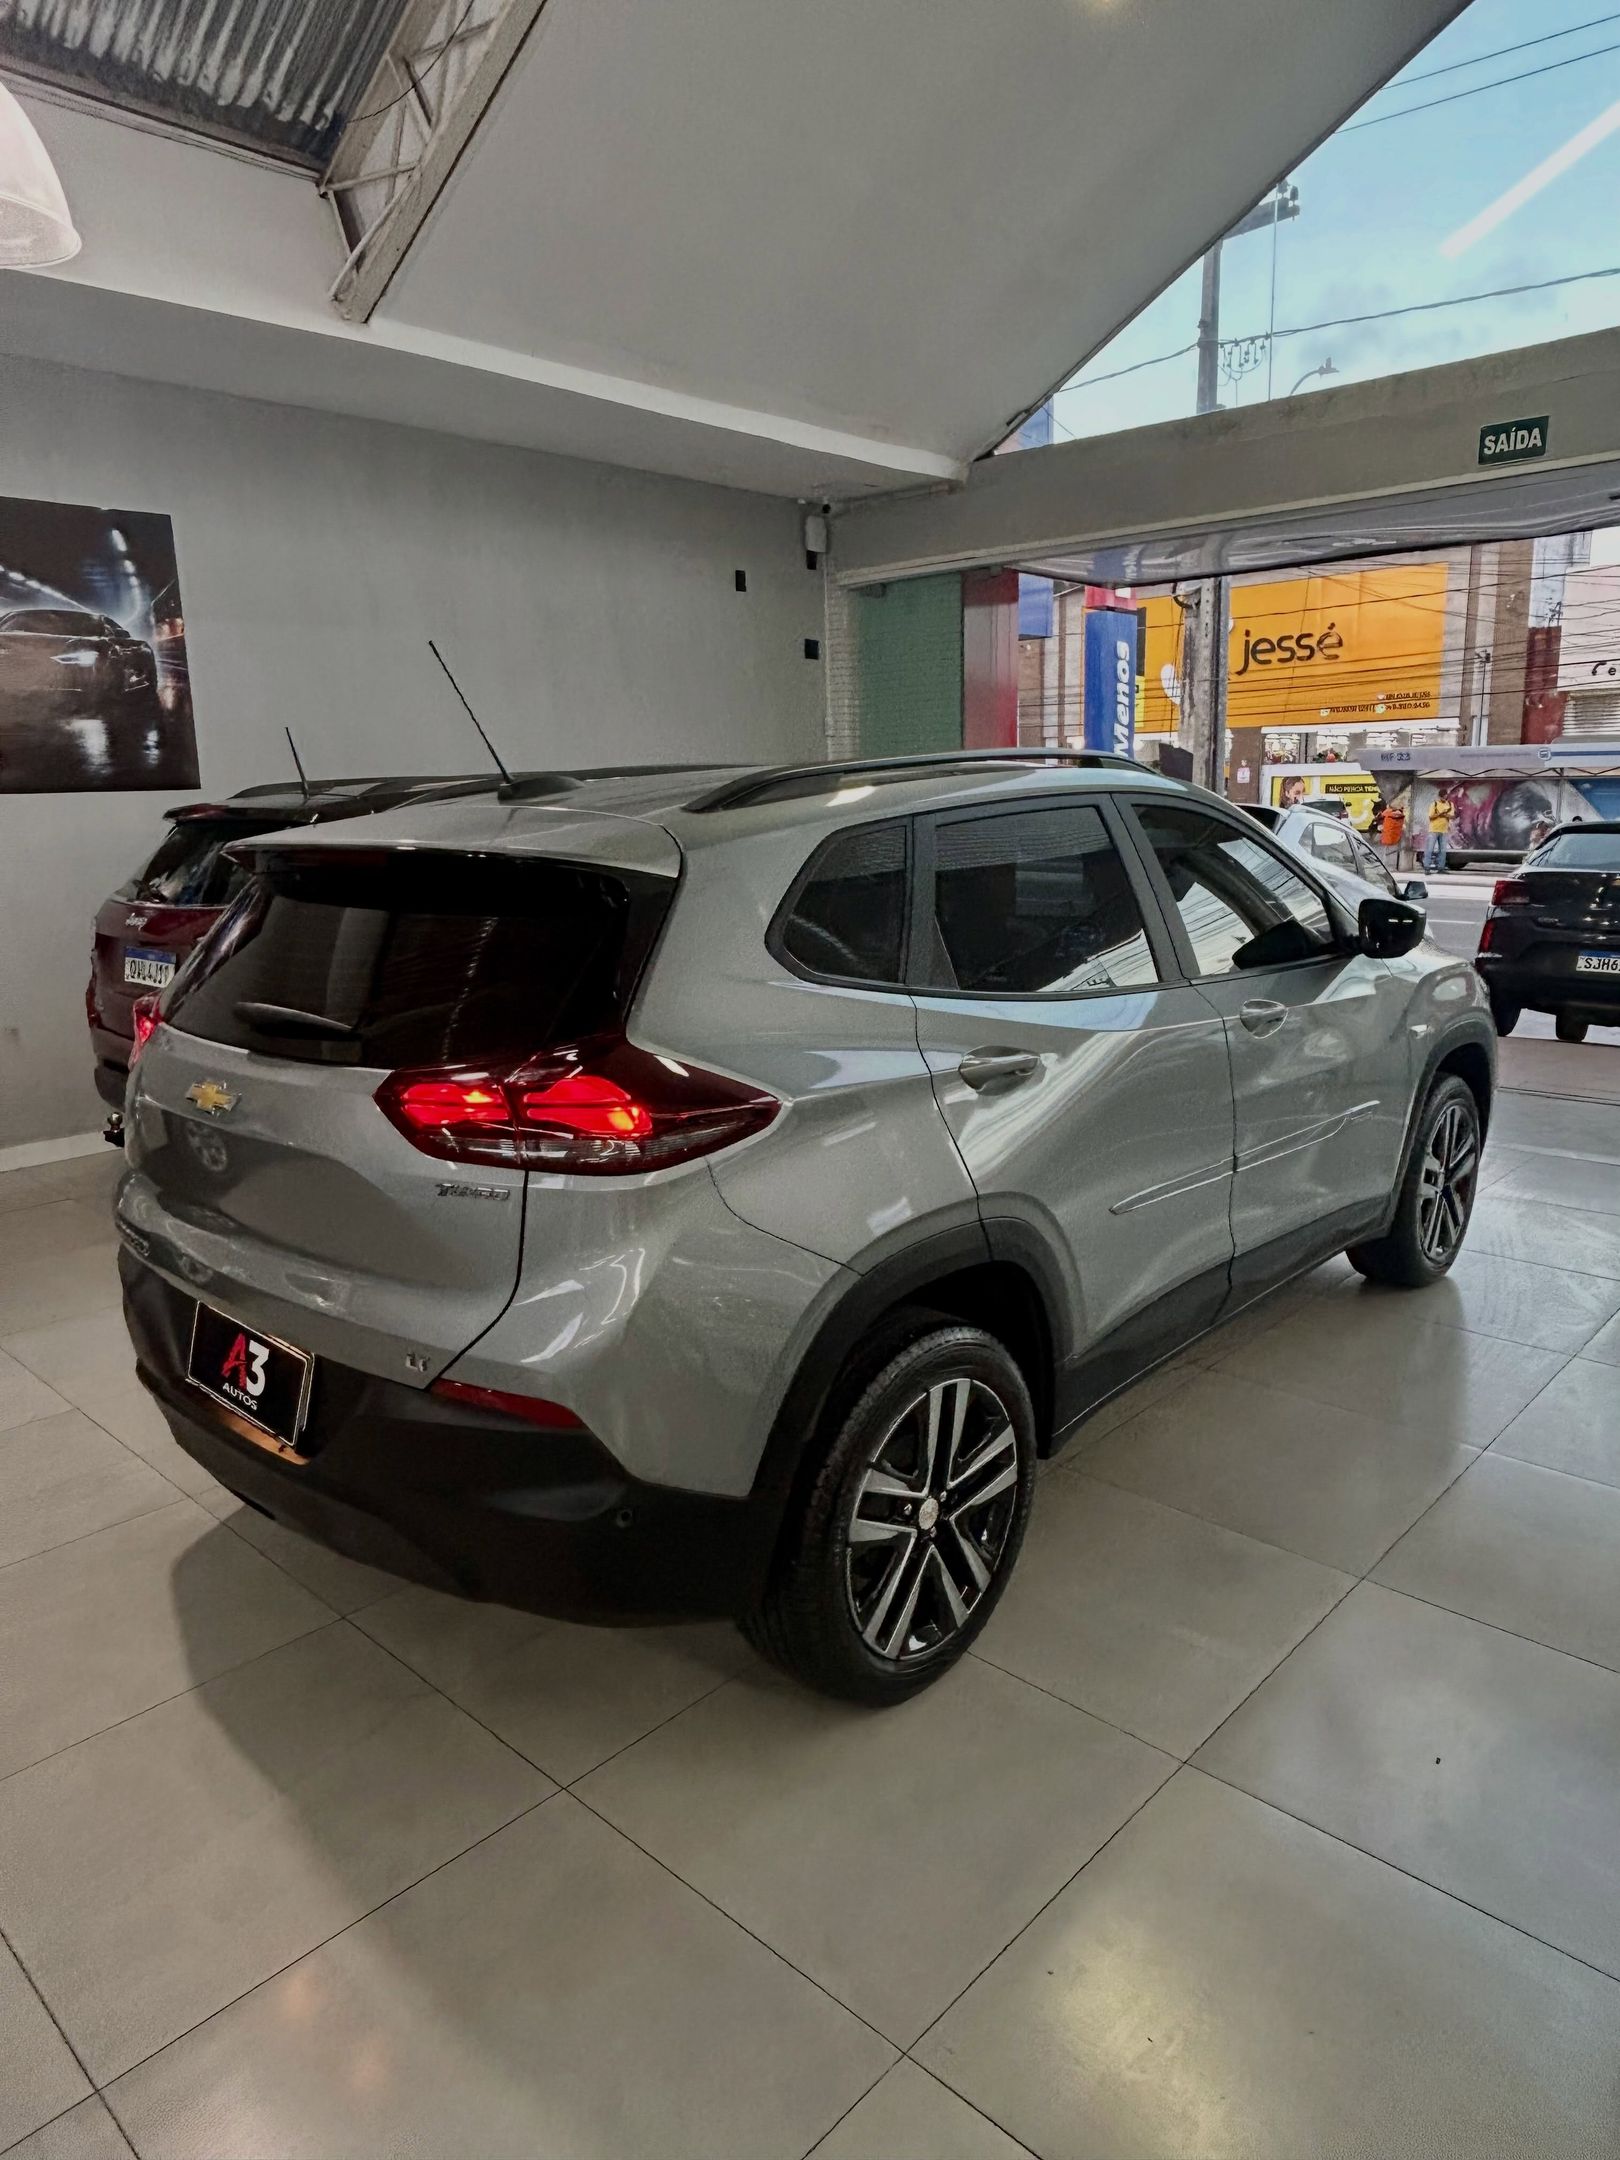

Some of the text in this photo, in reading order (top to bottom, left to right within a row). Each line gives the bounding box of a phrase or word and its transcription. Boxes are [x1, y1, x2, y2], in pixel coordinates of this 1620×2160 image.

[1483, 426, 1542, 455] SAÍDA
[1235, 622, 1343, 676] jessé
[1113, 641, 1130, 758] Menos
[1583, 957, 1620, 972] SJH6
[219, 1332, 270, 1397] A3
[222, 1383, 258, 1411] AUTOS
